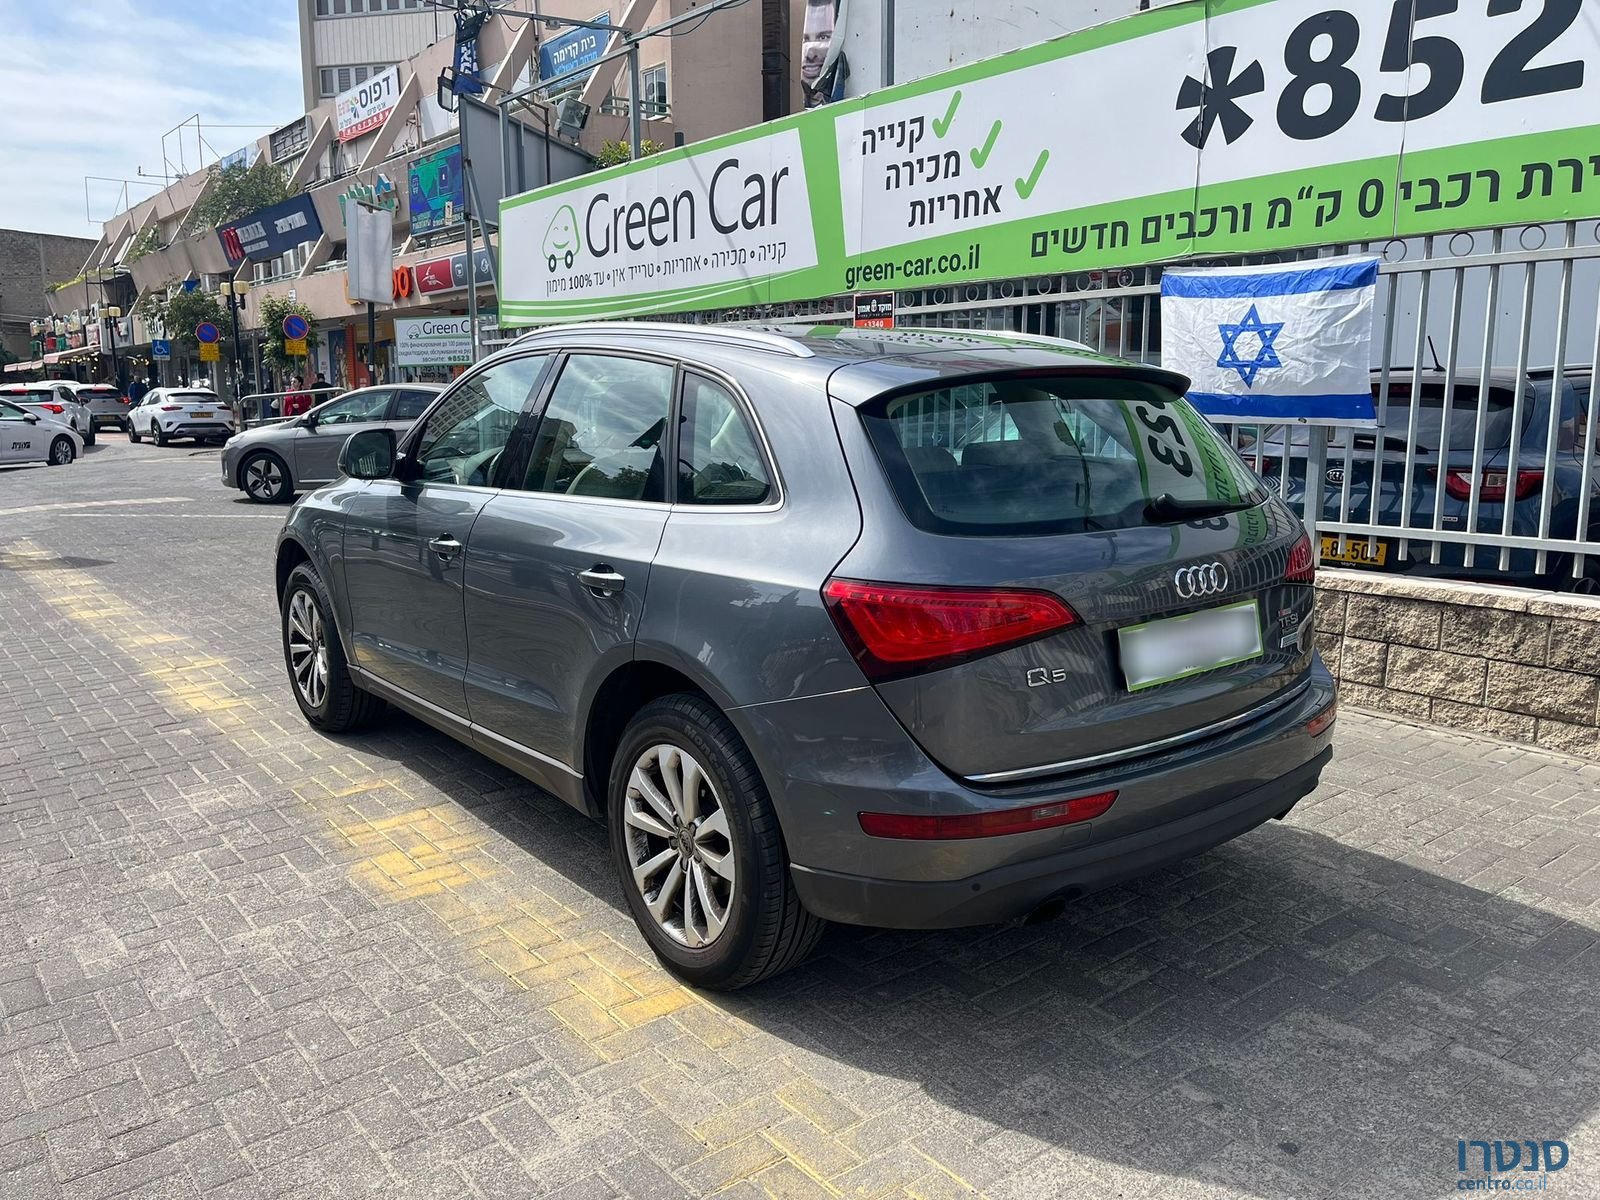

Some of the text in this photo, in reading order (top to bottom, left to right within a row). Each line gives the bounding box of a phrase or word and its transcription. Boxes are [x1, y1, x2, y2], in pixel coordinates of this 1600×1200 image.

[553, 35, 596, 65] בית קדימה
[359, 76, 390, 109] דפוס
[861, 115, 925, 155] קנייה
[885, 149, 961, 191] מכירה
[586, 158, 789, 258] Green Car
[907, 184, 1004, 228] אחריות
[1357, 177, 1385, 218] 0
[1398, 169, 1501, 213] רכבי
[1030, 220, 1129, 259] חדשים
[1140, 201, 1252, 245] ורכבים
[545, 241, 787, 297] קניה מכירה אחריות טרייד אין עד 100% מימון
[845, 243, 981, 289] green-car.co.il
[423, 321, 458, 335] Green
[857, 304, 892, 315] מוקד אמון
[1026, 667, 1067, 688] Q5
